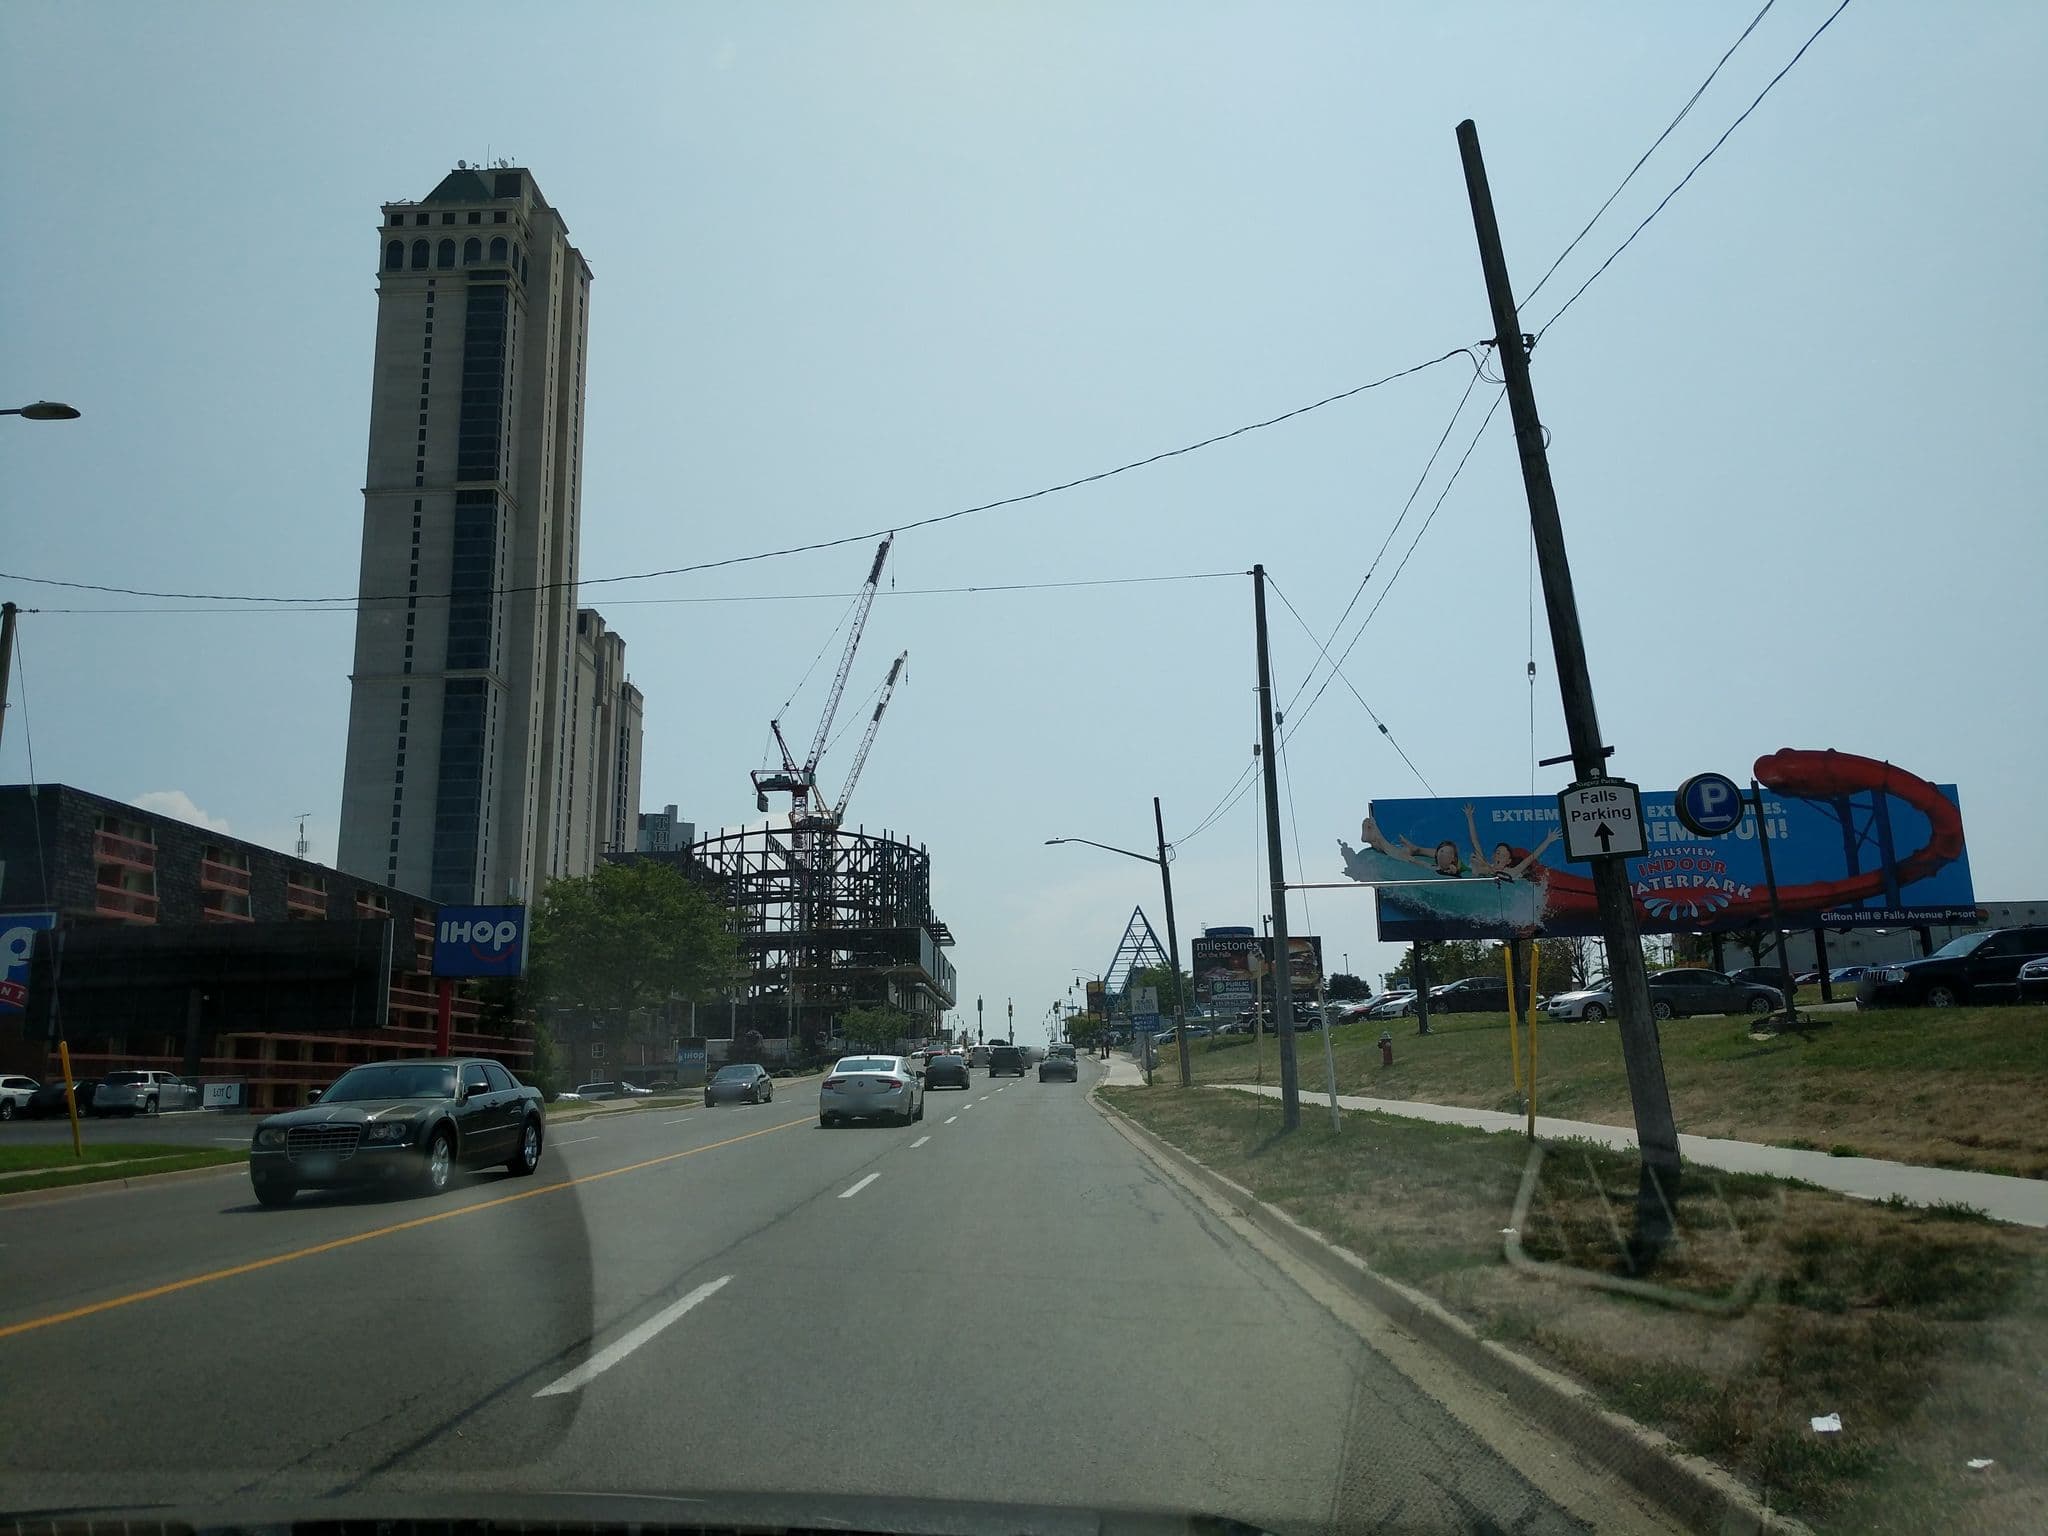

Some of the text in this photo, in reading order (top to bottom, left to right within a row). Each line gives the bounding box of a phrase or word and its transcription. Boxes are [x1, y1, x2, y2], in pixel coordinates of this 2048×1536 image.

[1580, 790, 1617, 804] Falls
[1701, 783, 1728, 813] P
[1492, 808, 1560, 822] EXTREM
[1571, 807, 1632, 822] Parking
[1637, 857, 1727, 877] INDOOR
[1629, 874, 1753, 899] ATERPARK
[1821, 912, 1852, 922] Clifton
[1855, 912, 1872, 921] Hill
[1873, 912, 1881, 920] @
[1884, 911, 1905, 920] Falls
[1907, 911, 1943, 920] Avenue
[1196, 940, 1260, 951] milestones
